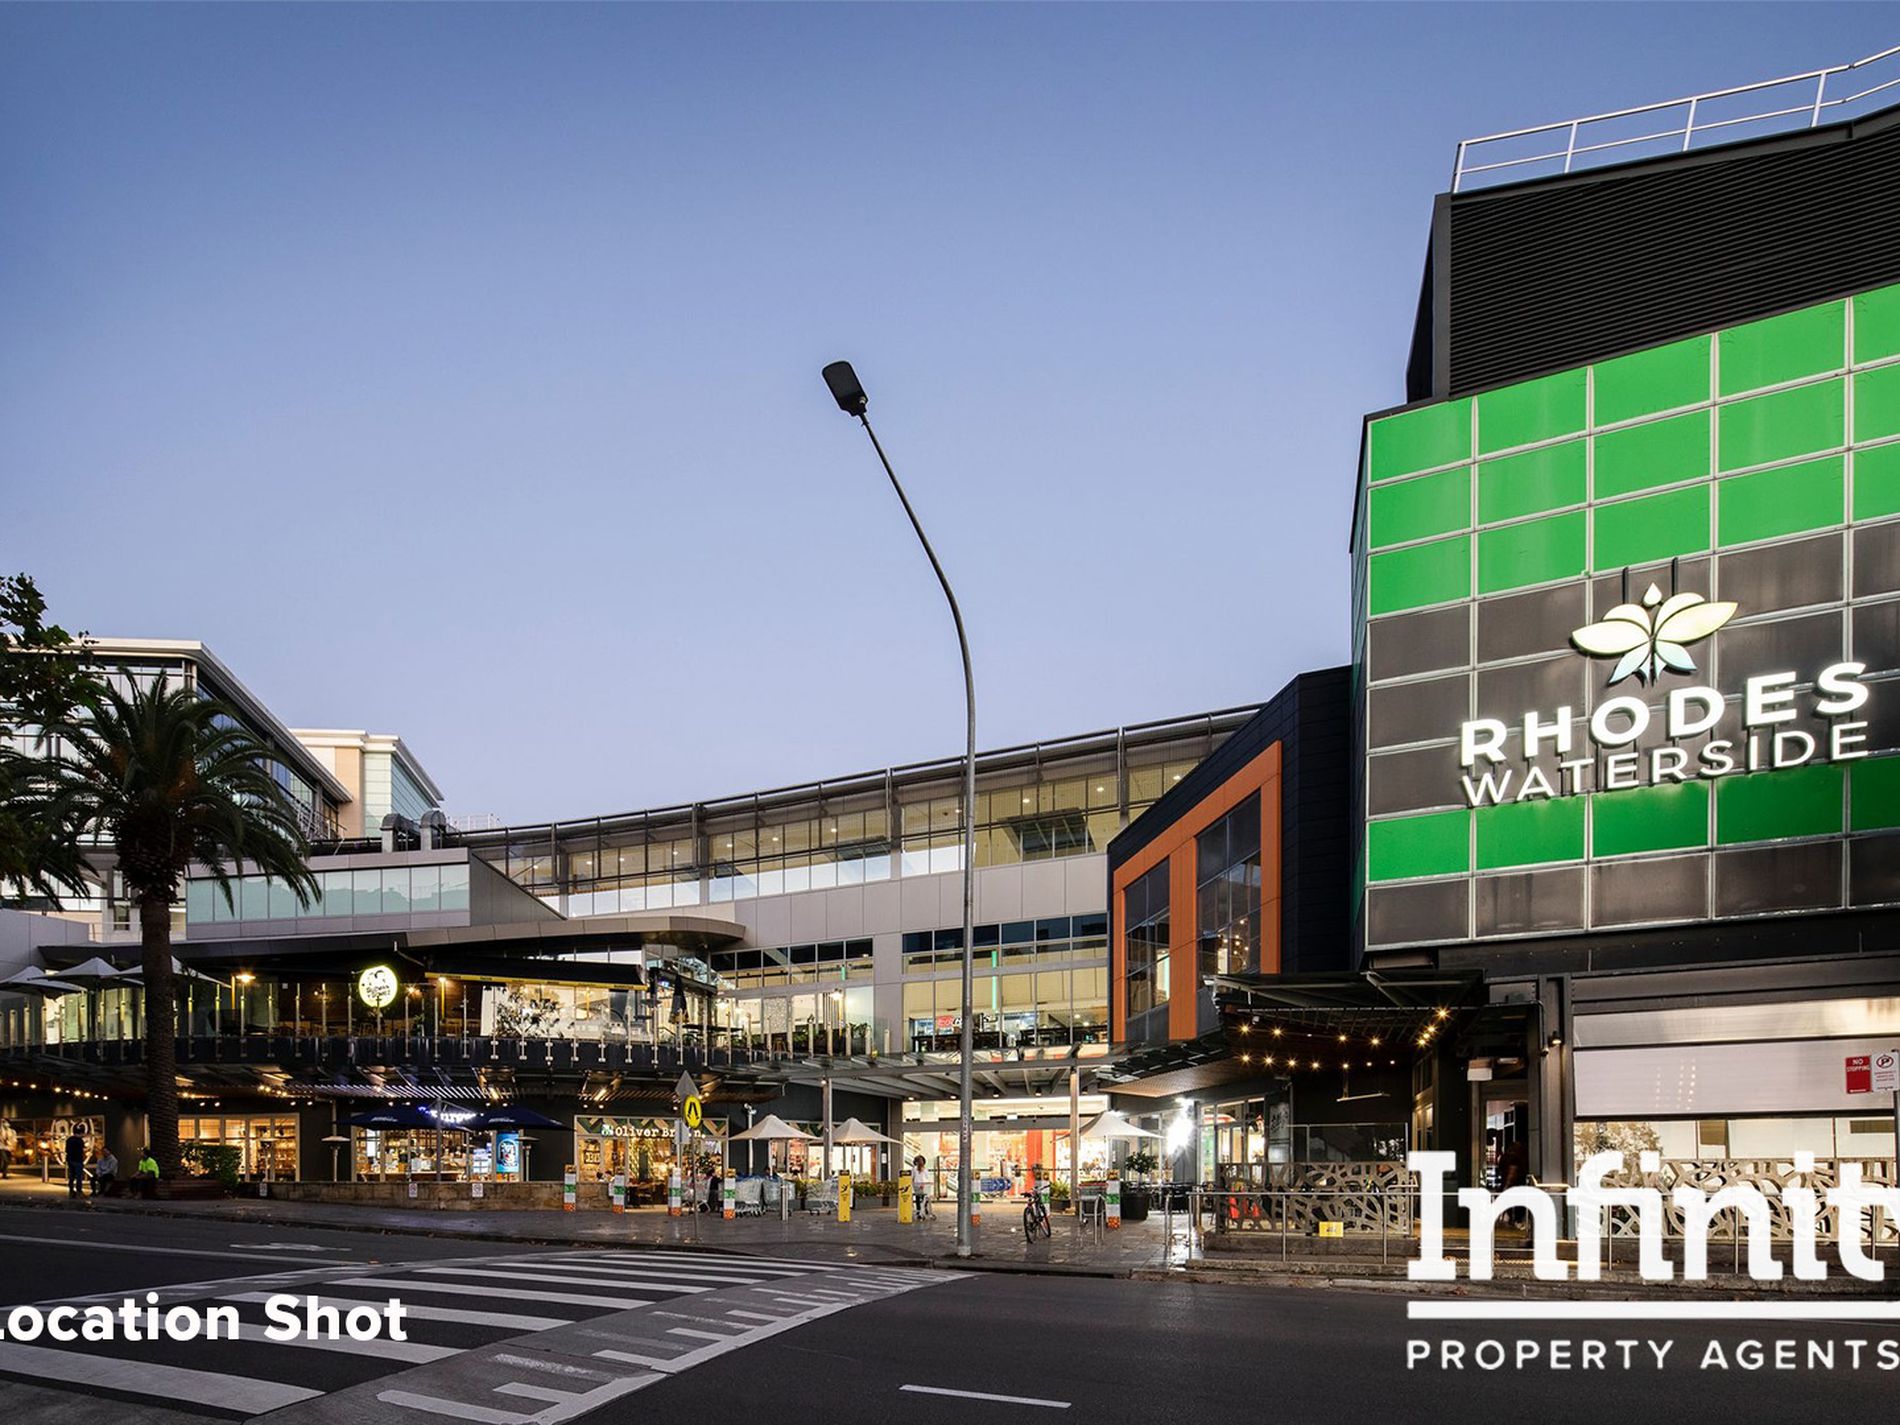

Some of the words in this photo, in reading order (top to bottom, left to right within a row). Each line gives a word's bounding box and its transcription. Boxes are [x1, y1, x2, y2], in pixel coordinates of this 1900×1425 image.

[1461, 661, 1869, 767] RHODES
[1462, 721, 1870, 806] WATERSIDE
[1852, 1058, 1864, 1066] NO
[615, 1125, 659, 1138] Oliver
[661, 1127, 706, 1139] Brn.
